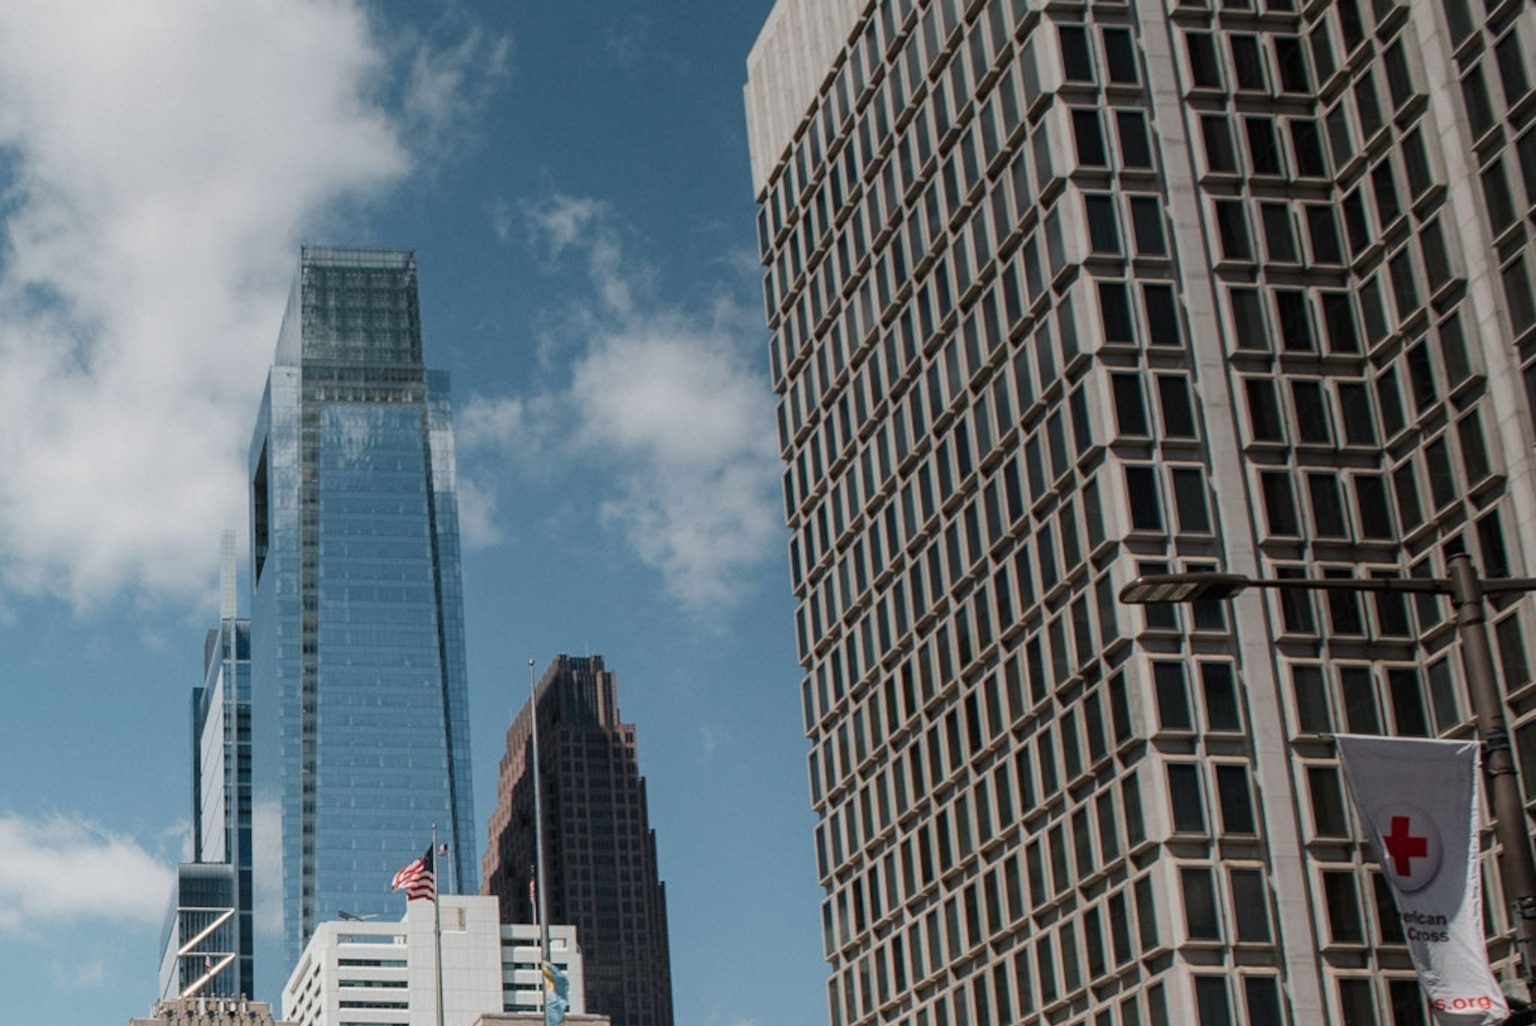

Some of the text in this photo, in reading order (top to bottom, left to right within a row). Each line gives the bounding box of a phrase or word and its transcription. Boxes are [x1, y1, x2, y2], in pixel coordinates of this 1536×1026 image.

[1403, 911, 1447, 925] erican
[1408, 927, 1450, 942] Cross
[1434, 995, 1492, 1011] s.org
